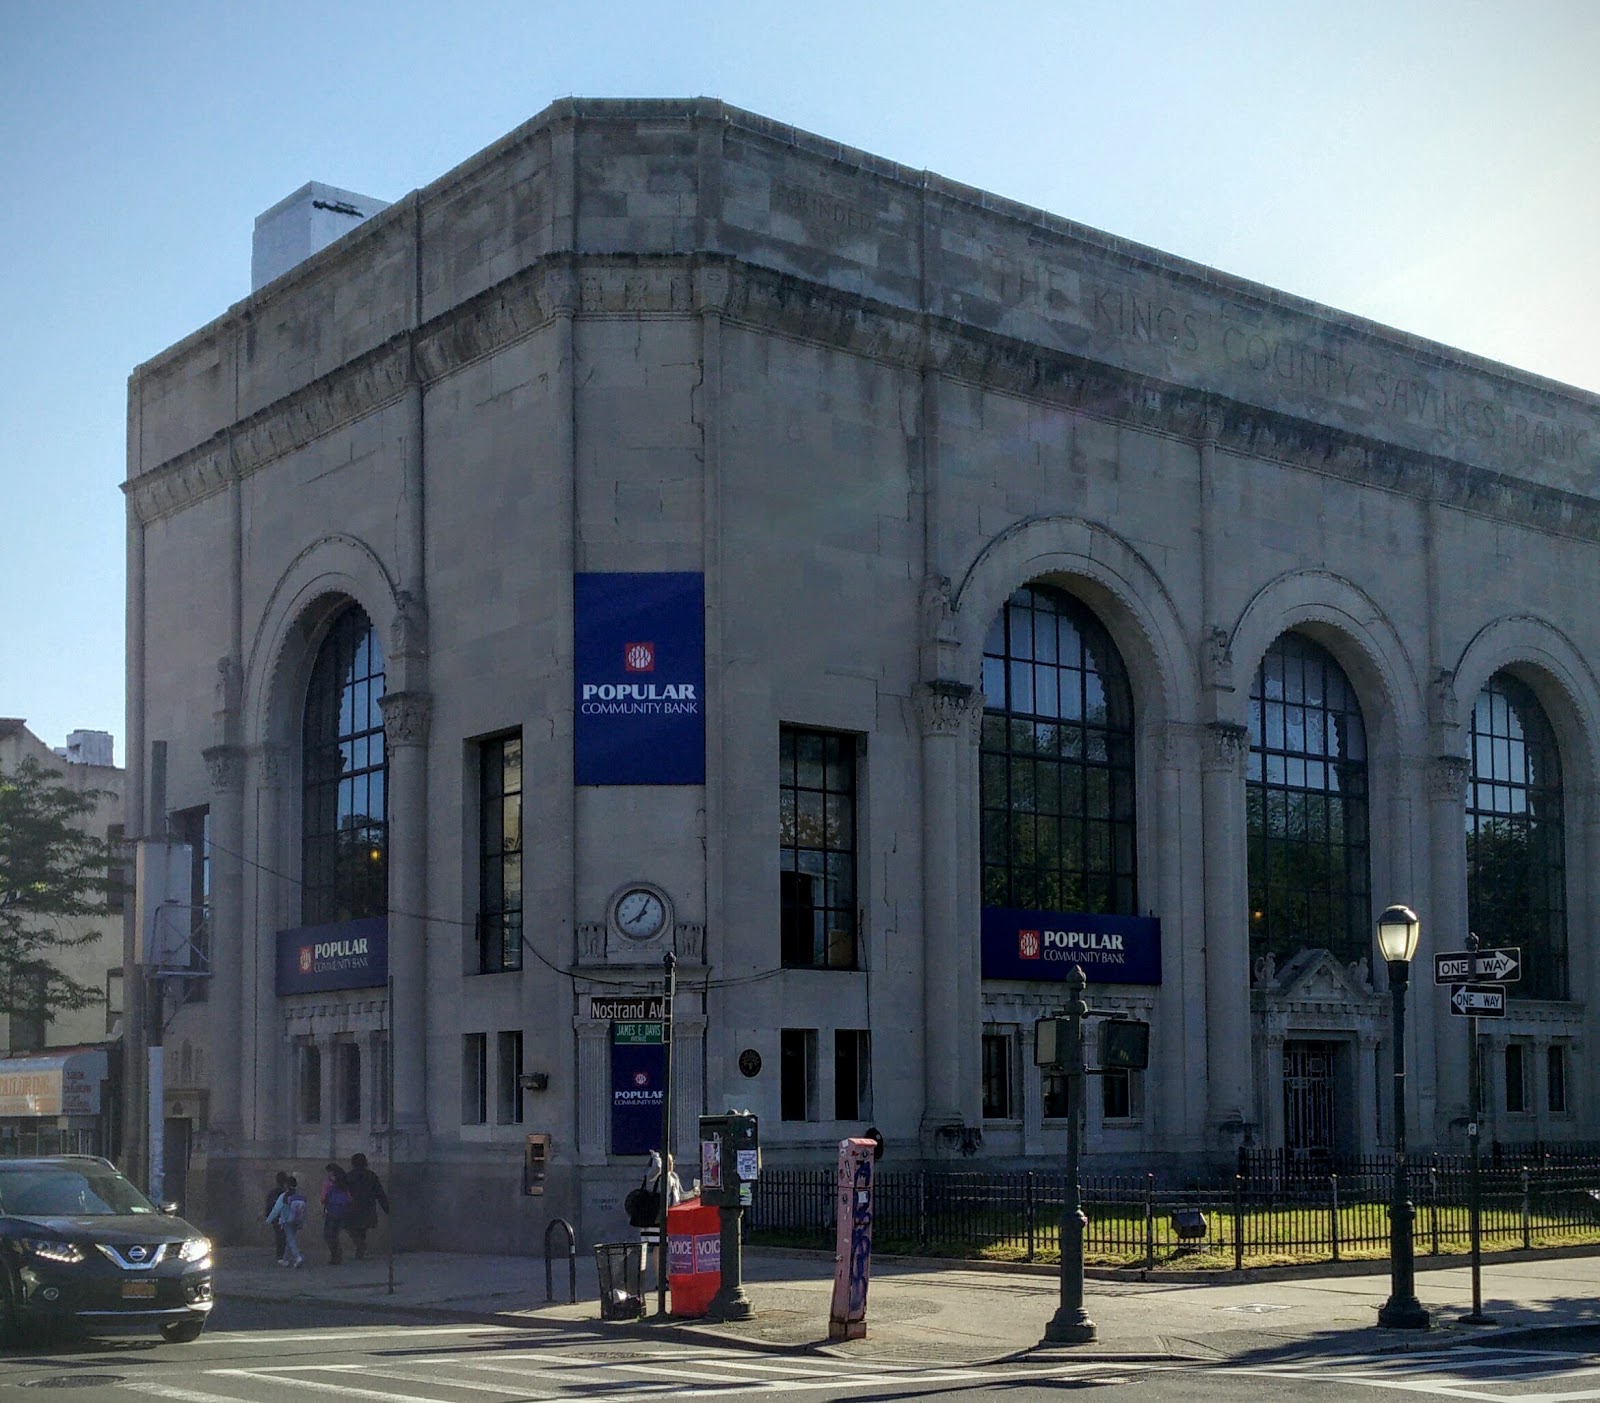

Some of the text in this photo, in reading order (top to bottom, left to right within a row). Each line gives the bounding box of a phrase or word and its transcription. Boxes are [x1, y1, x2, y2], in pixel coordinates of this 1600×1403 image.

[1093, 287, 1199, 352] KINGS
[1222, 326, 1356, 398] COUNTY
[1375, 371, 1497, 438] SAVINGS
[582, 683, 697, 701] POPULAR
[581, 702, 698, 715] COMMUNITY BANK
[314, 937, 369, 959] POPULAR
[1043, 930, 1124, 950] POPULAR
[313, 956, 369, 973] COMMUNITY BANK
[1043, 949, 1125, 964] COMMUNITY BANK
[1441, 958, 1510, 975] ONE WAY
[1456, 993, 1501, 1008] ONE WAY
[591, 1000, 645, 1019] Nostrand
[616, 1024, 636, 1037] JAMES
[645, 1024, 661, 1036] DAVIS
